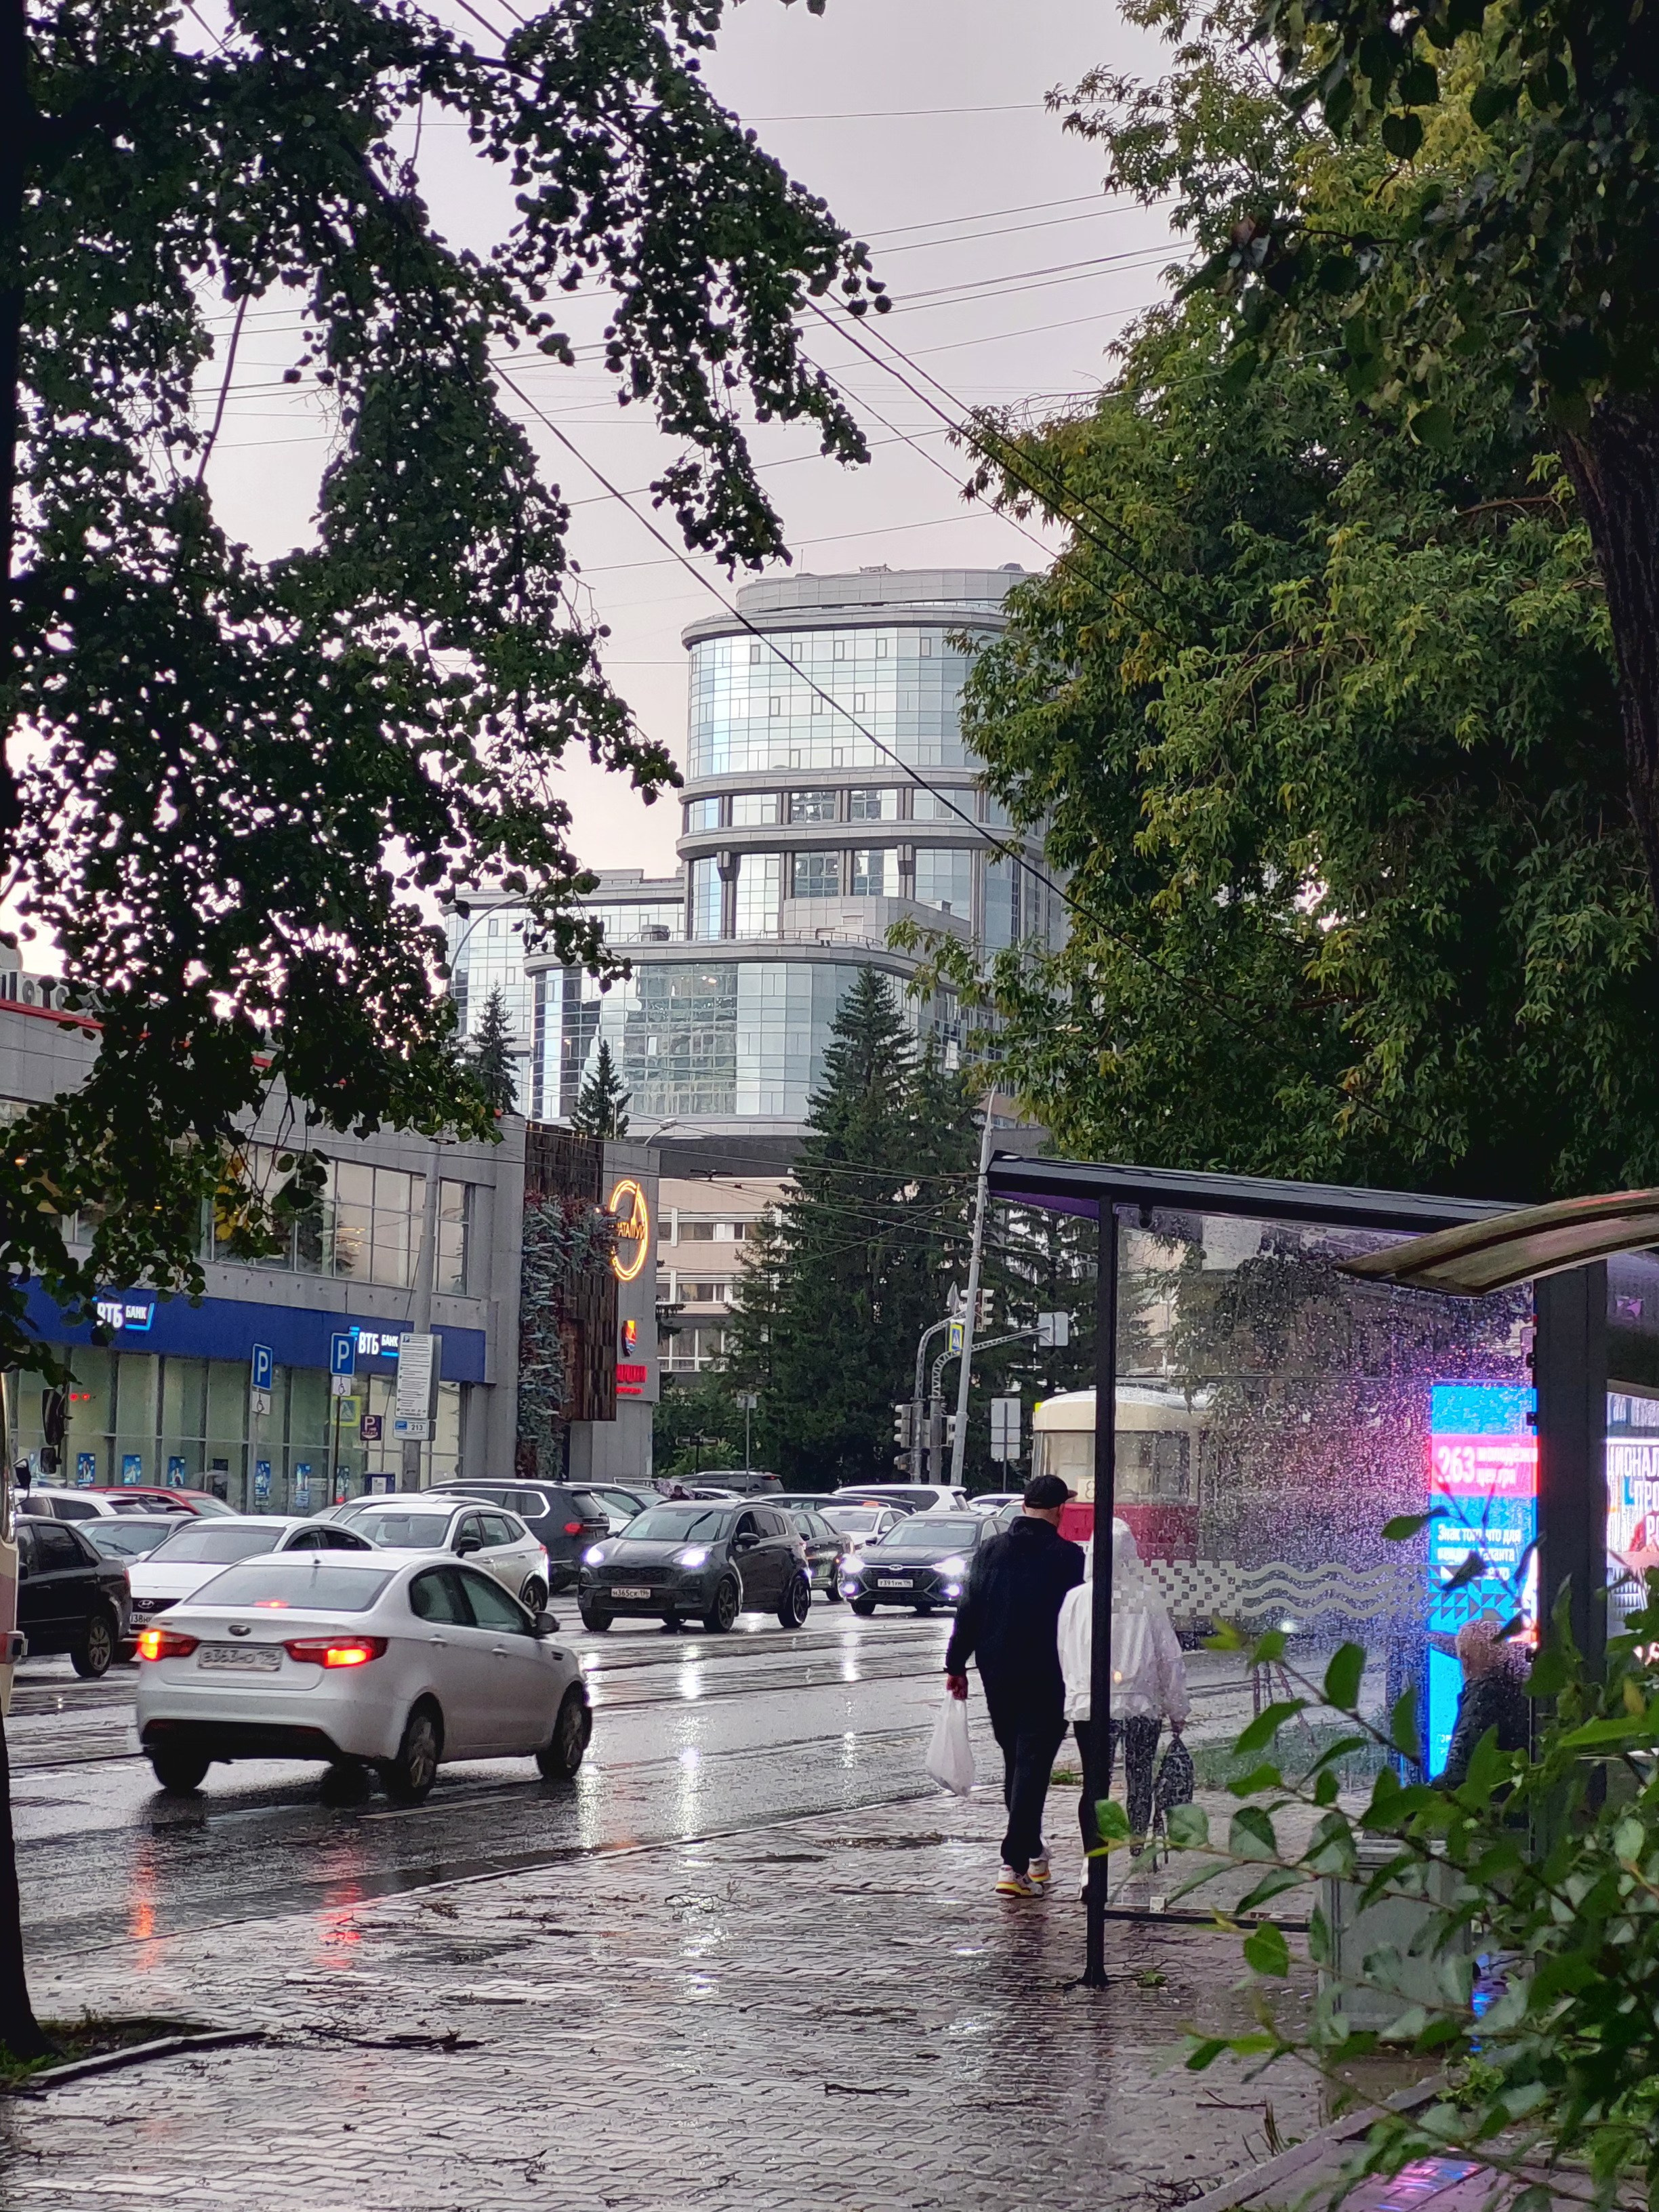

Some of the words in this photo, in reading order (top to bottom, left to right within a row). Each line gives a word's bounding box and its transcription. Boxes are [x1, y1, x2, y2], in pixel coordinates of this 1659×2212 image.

[97, 1302, 123, 1328] ВТБ
[125, 1305, 147, 1319] БАНК
[337, 1340, 350, 1370] P
[358, 1332, 380, 1355] ВТБ
[381, 1334, 399, 1347] БАНК
[258, 1350, 268, 1382] P
[1437, 1446, 1475, 1483] 263
[1607, 1446, 1659, 1479] ЦИОНАЛ
[1634, 1480, 1659, 1512] ПРО
